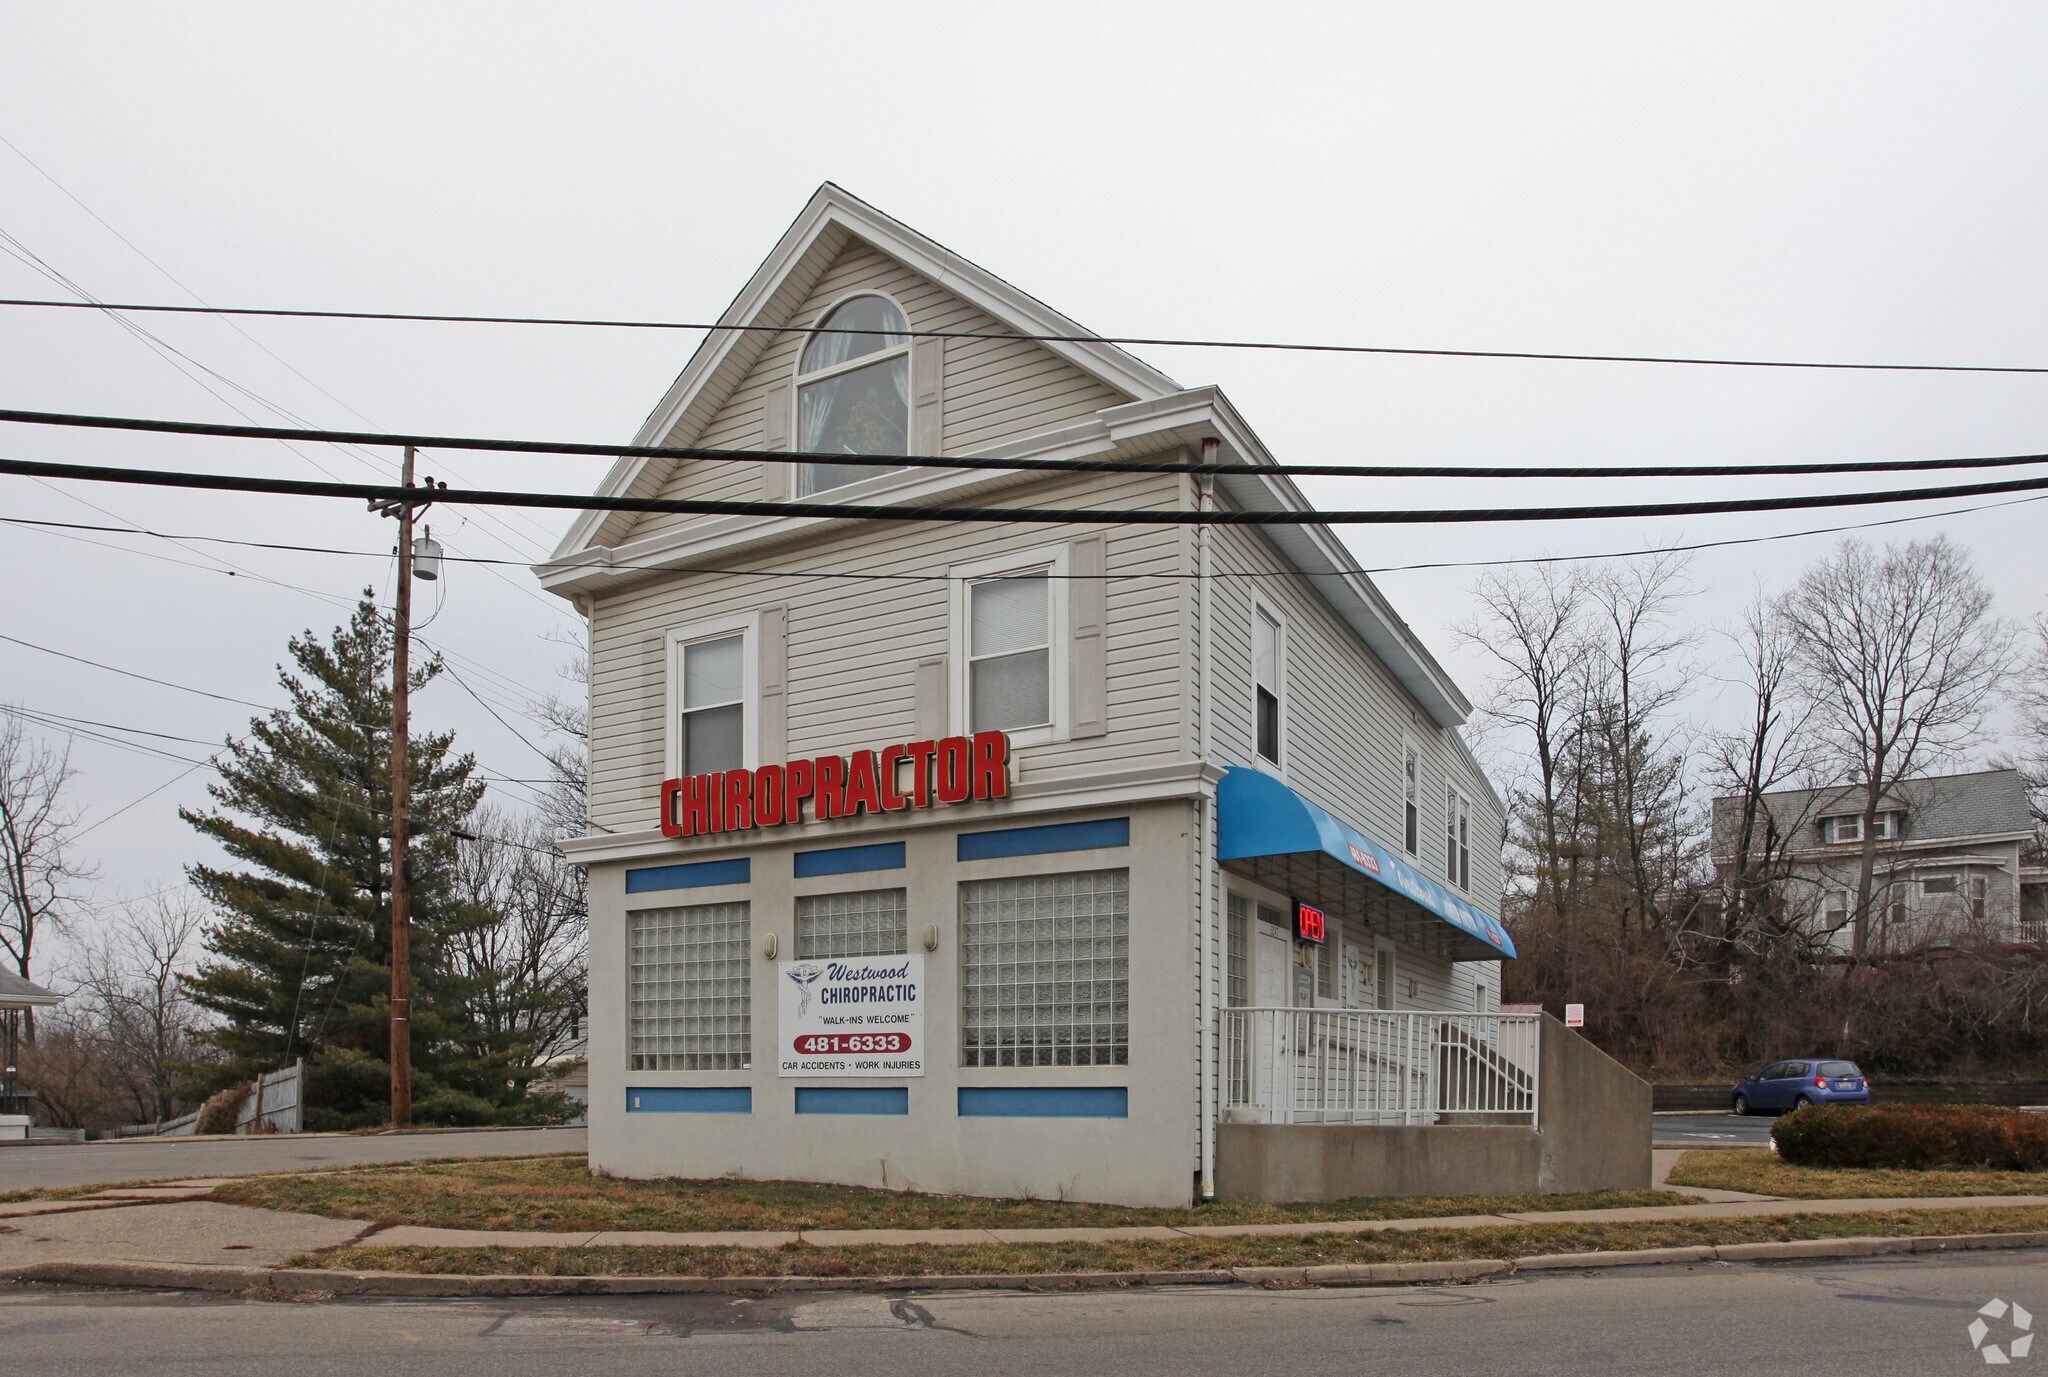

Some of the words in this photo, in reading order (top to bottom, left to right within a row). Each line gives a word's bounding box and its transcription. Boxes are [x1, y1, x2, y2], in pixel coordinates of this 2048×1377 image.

[660, 730, 1010, 838] CHIROPRACTOR
[1300, 906, 1325, 941] OPEN
[827, 961, 910, 982] Westwood
[821, 984, 916, 1004] CHIROPRACTIC
[804, 1035, 900, 1052] 481-6333
[782, 1062, 798, 1070] CAR
[801, 1061, 846, 1070] ACCIDENTS
[855, 1061, 880, 1070] WORK
[883, 1060, 921, 1070] INJURIES
